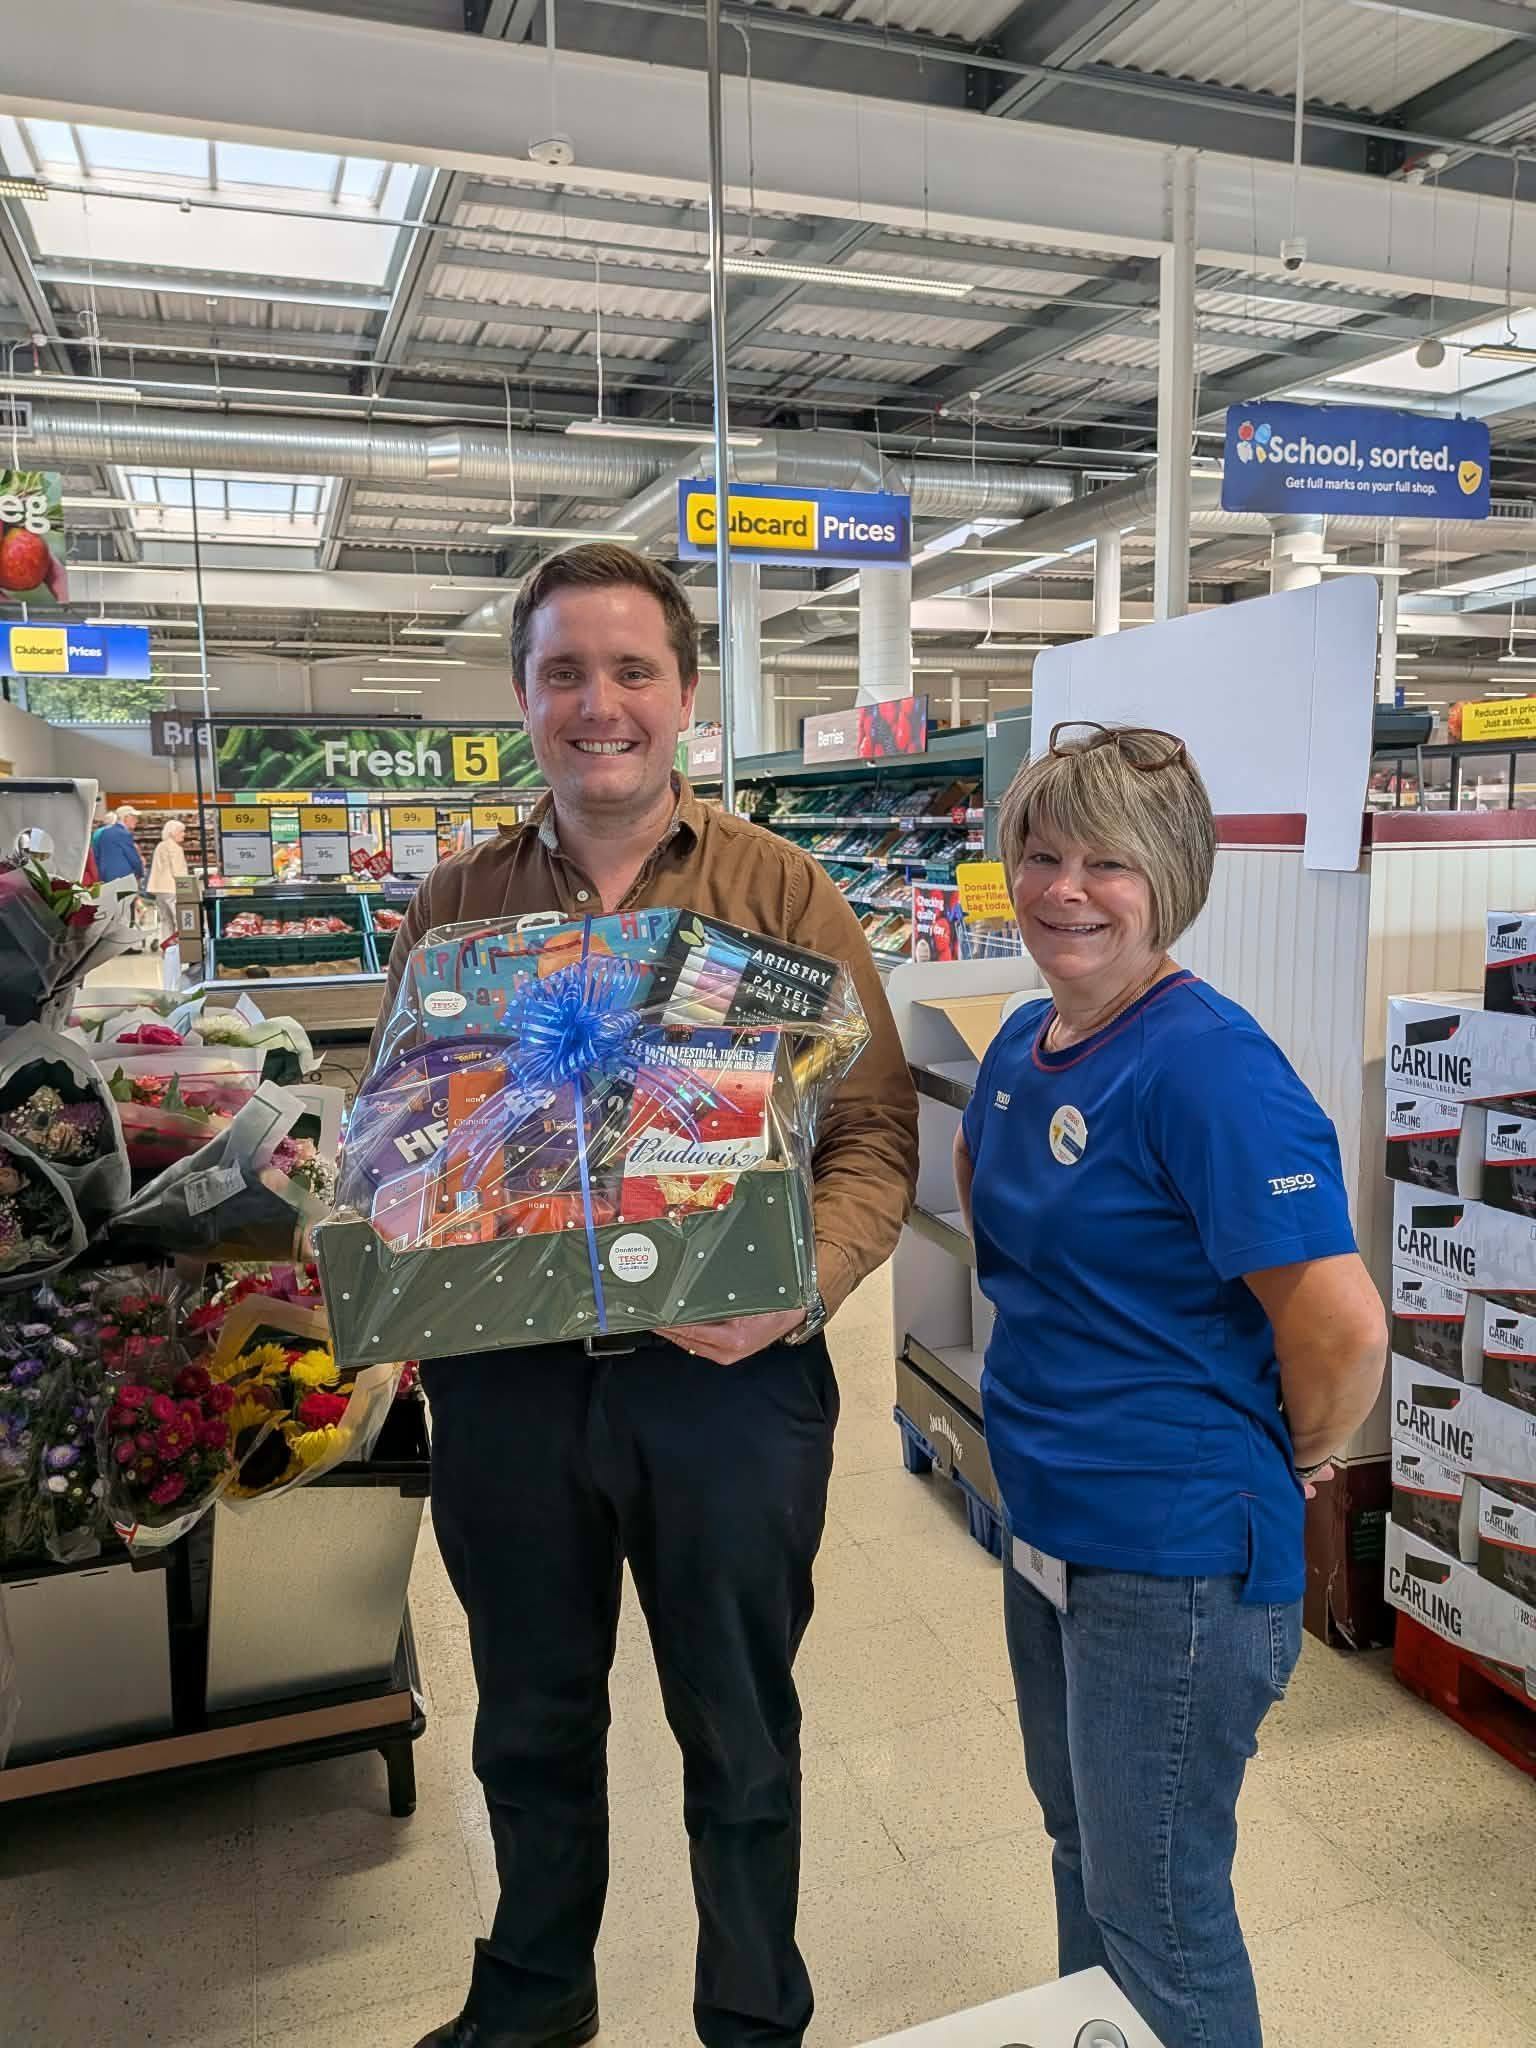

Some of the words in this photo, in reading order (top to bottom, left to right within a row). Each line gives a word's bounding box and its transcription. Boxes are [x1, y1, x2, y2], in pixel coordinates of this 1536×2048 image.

[1270, 436, 1364, 471] School,
[1370, 445, 1456, 472] sorted.
[1286, 476, 1304, 489] Get
[1307, 477, 1324, 489] full
[1325, 479, 1355, 491] marks
[1357, 482, 1369, 491] on
[1372, 483, 1393, 494] your
[1396, 481, 1410, 493] full
[1412, 484, 1437, 495] shop.
[696, 508, 808, 537] Cubcard
[823, 515, 896, 542] Prices
[15, 644, 63, 655] Clubcard
[69, 645, 102, 657] Prices
[1474, 707, 1508, 718] Reduced
[1510, 706, 1517, 714] in
[1484, 718, 1501, 729] Just
[1502, 718, 1512, 726] as
[1513, 716, 1532, 727] nice.
[818, 728, 844, 747] Berries
[325, 741, 442, 777] Fresh
[465, 741, 488, 776] 5
[235, 814, 255, 824] 69p
[314, 814, 333, 824] 59p
[964, 883, 996, 892] Donate
[967, 902, 984, 912] bag
[985, 901, 1010, 911] today
[1490, 935, 1527, 951] CARLING
[753, 949, 832, 987] ARTISTRY
[753, 976, 811, 1005] PASTEL
[746, 985, 776, 1003] PEN
[782, 999, 813, 1017] SET
[679, 1047, 717, 1060] FESTIVAL
[720, 1048, 755, 1061] TICKETS
[1391, 1044, 1472, 1088] CARLING
[1405, 1078, 1433, 1090] ORIGINAL
[1439, 1103, 1447, 1116] 18
[1390, 1110, 1421, 1129] CARLING
[1490, 1133, 1527, 1154] CARLING
[1268, 1173, 1315, 1191] TESCO
[615, 1245, 642, 1253] Donated
[644, 1245, 651, 1253] by
[1398, 1224, 1476, 1277] CARLING
[1396, 1287, 1427, 1309] CARLING
[1489, 1325, 1524, 1350] CARLING
[1396, 1399, 1473, 1462] CARLING
[1395, 1460, 1425, 1486] CARLING
[1484, 1510, 1519, 1539] CARLING
[1389, 1566, 1462, 1638] CARLING
[1520, 1608, 1530, 1625] 18
